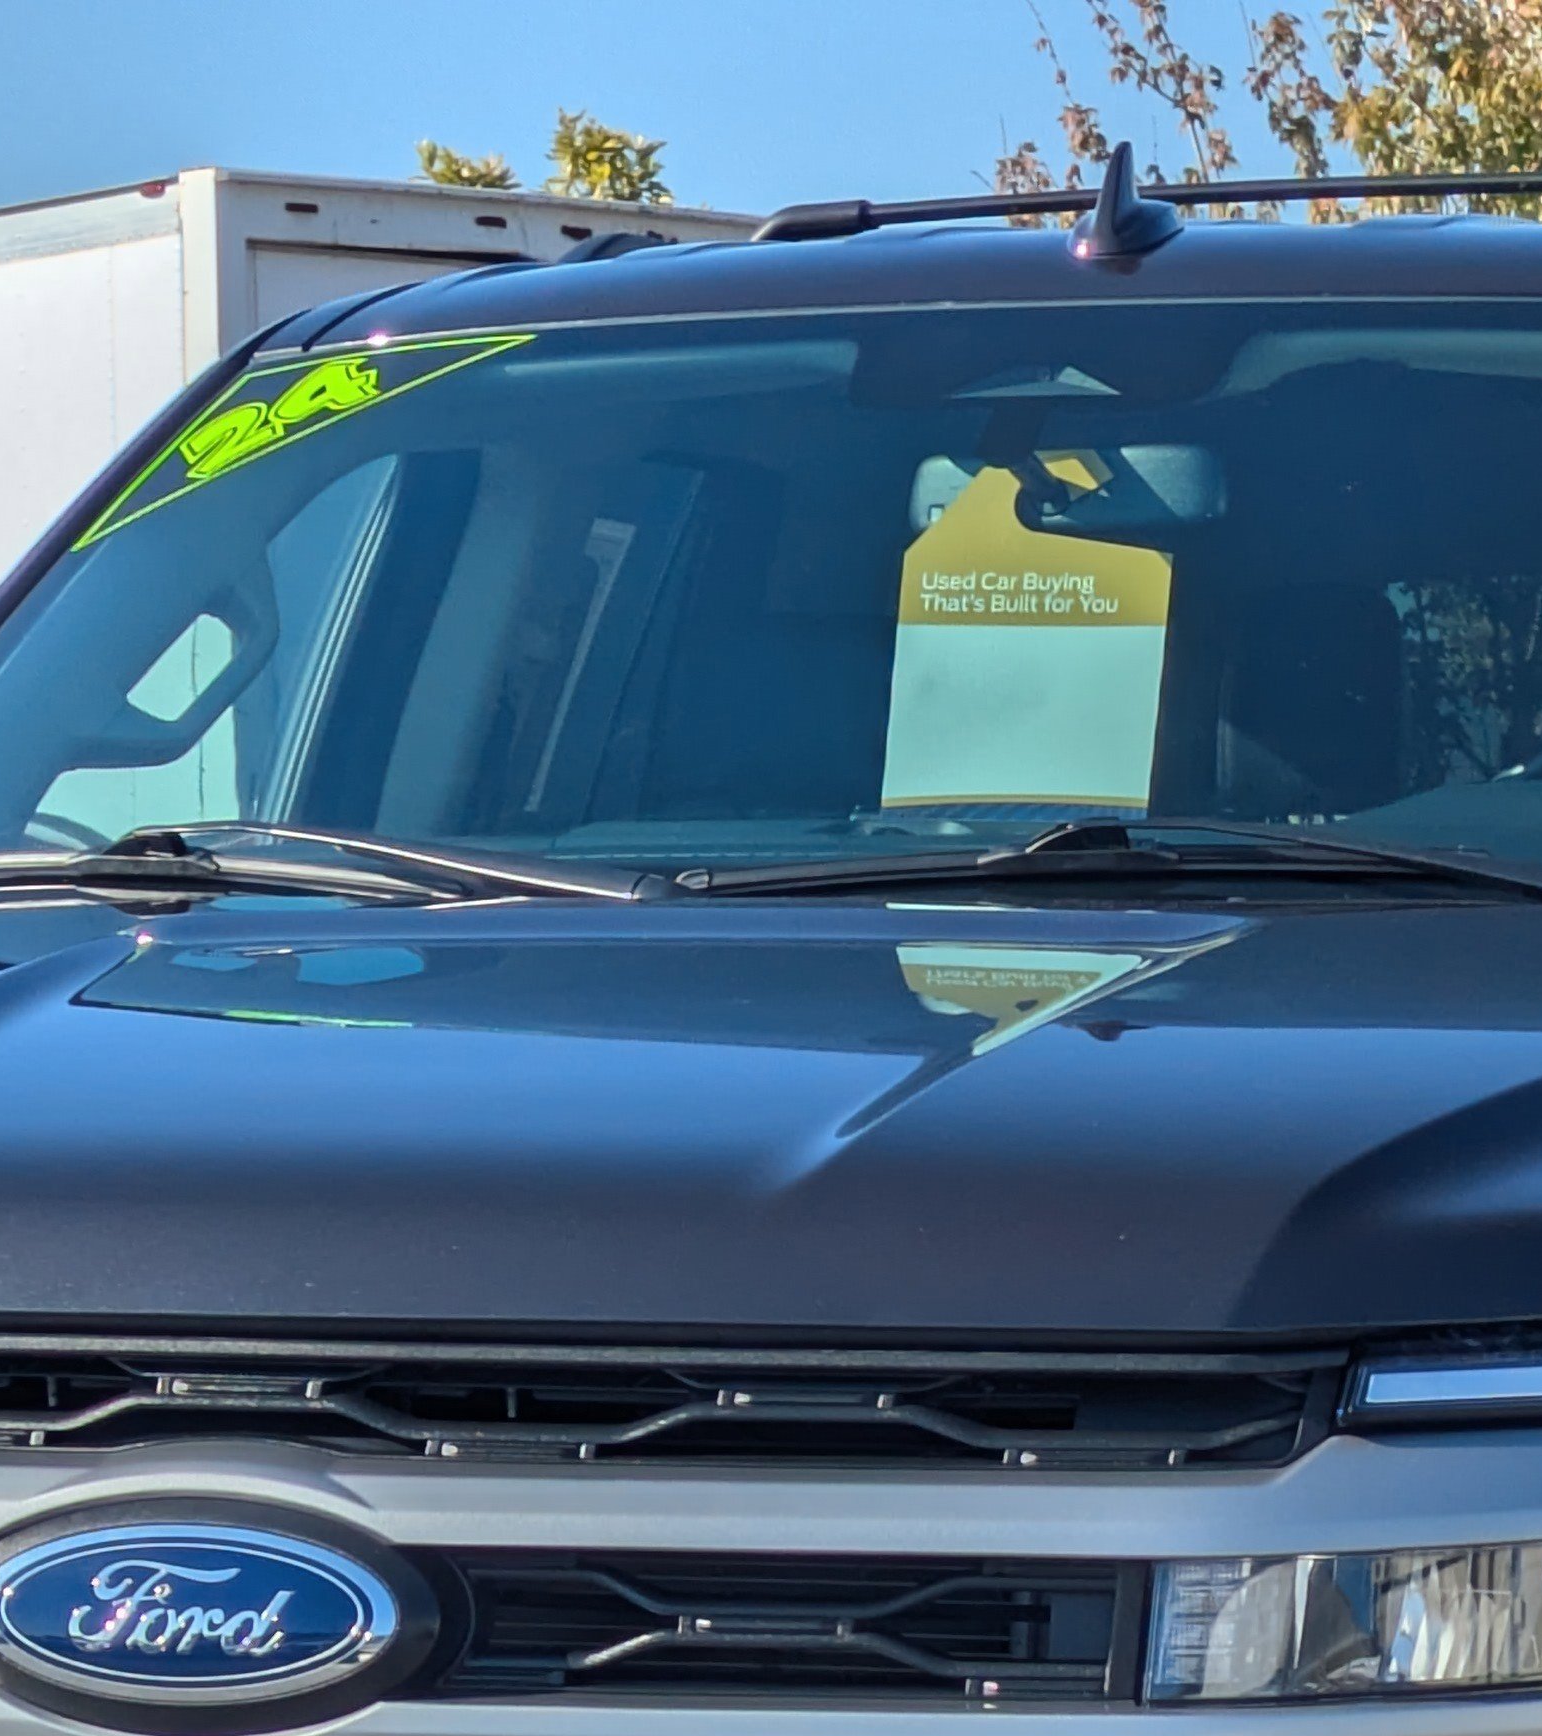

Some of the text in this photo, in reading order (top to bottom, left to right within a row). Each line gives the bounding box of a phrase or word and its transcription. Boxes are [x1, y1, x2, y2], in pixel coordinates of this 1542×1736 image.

[922, 571, 1095, 594] Used Car Buying
[920, 594, 1119, 613] That's Built for You
[68, 1559, 296, 1656] Ford
